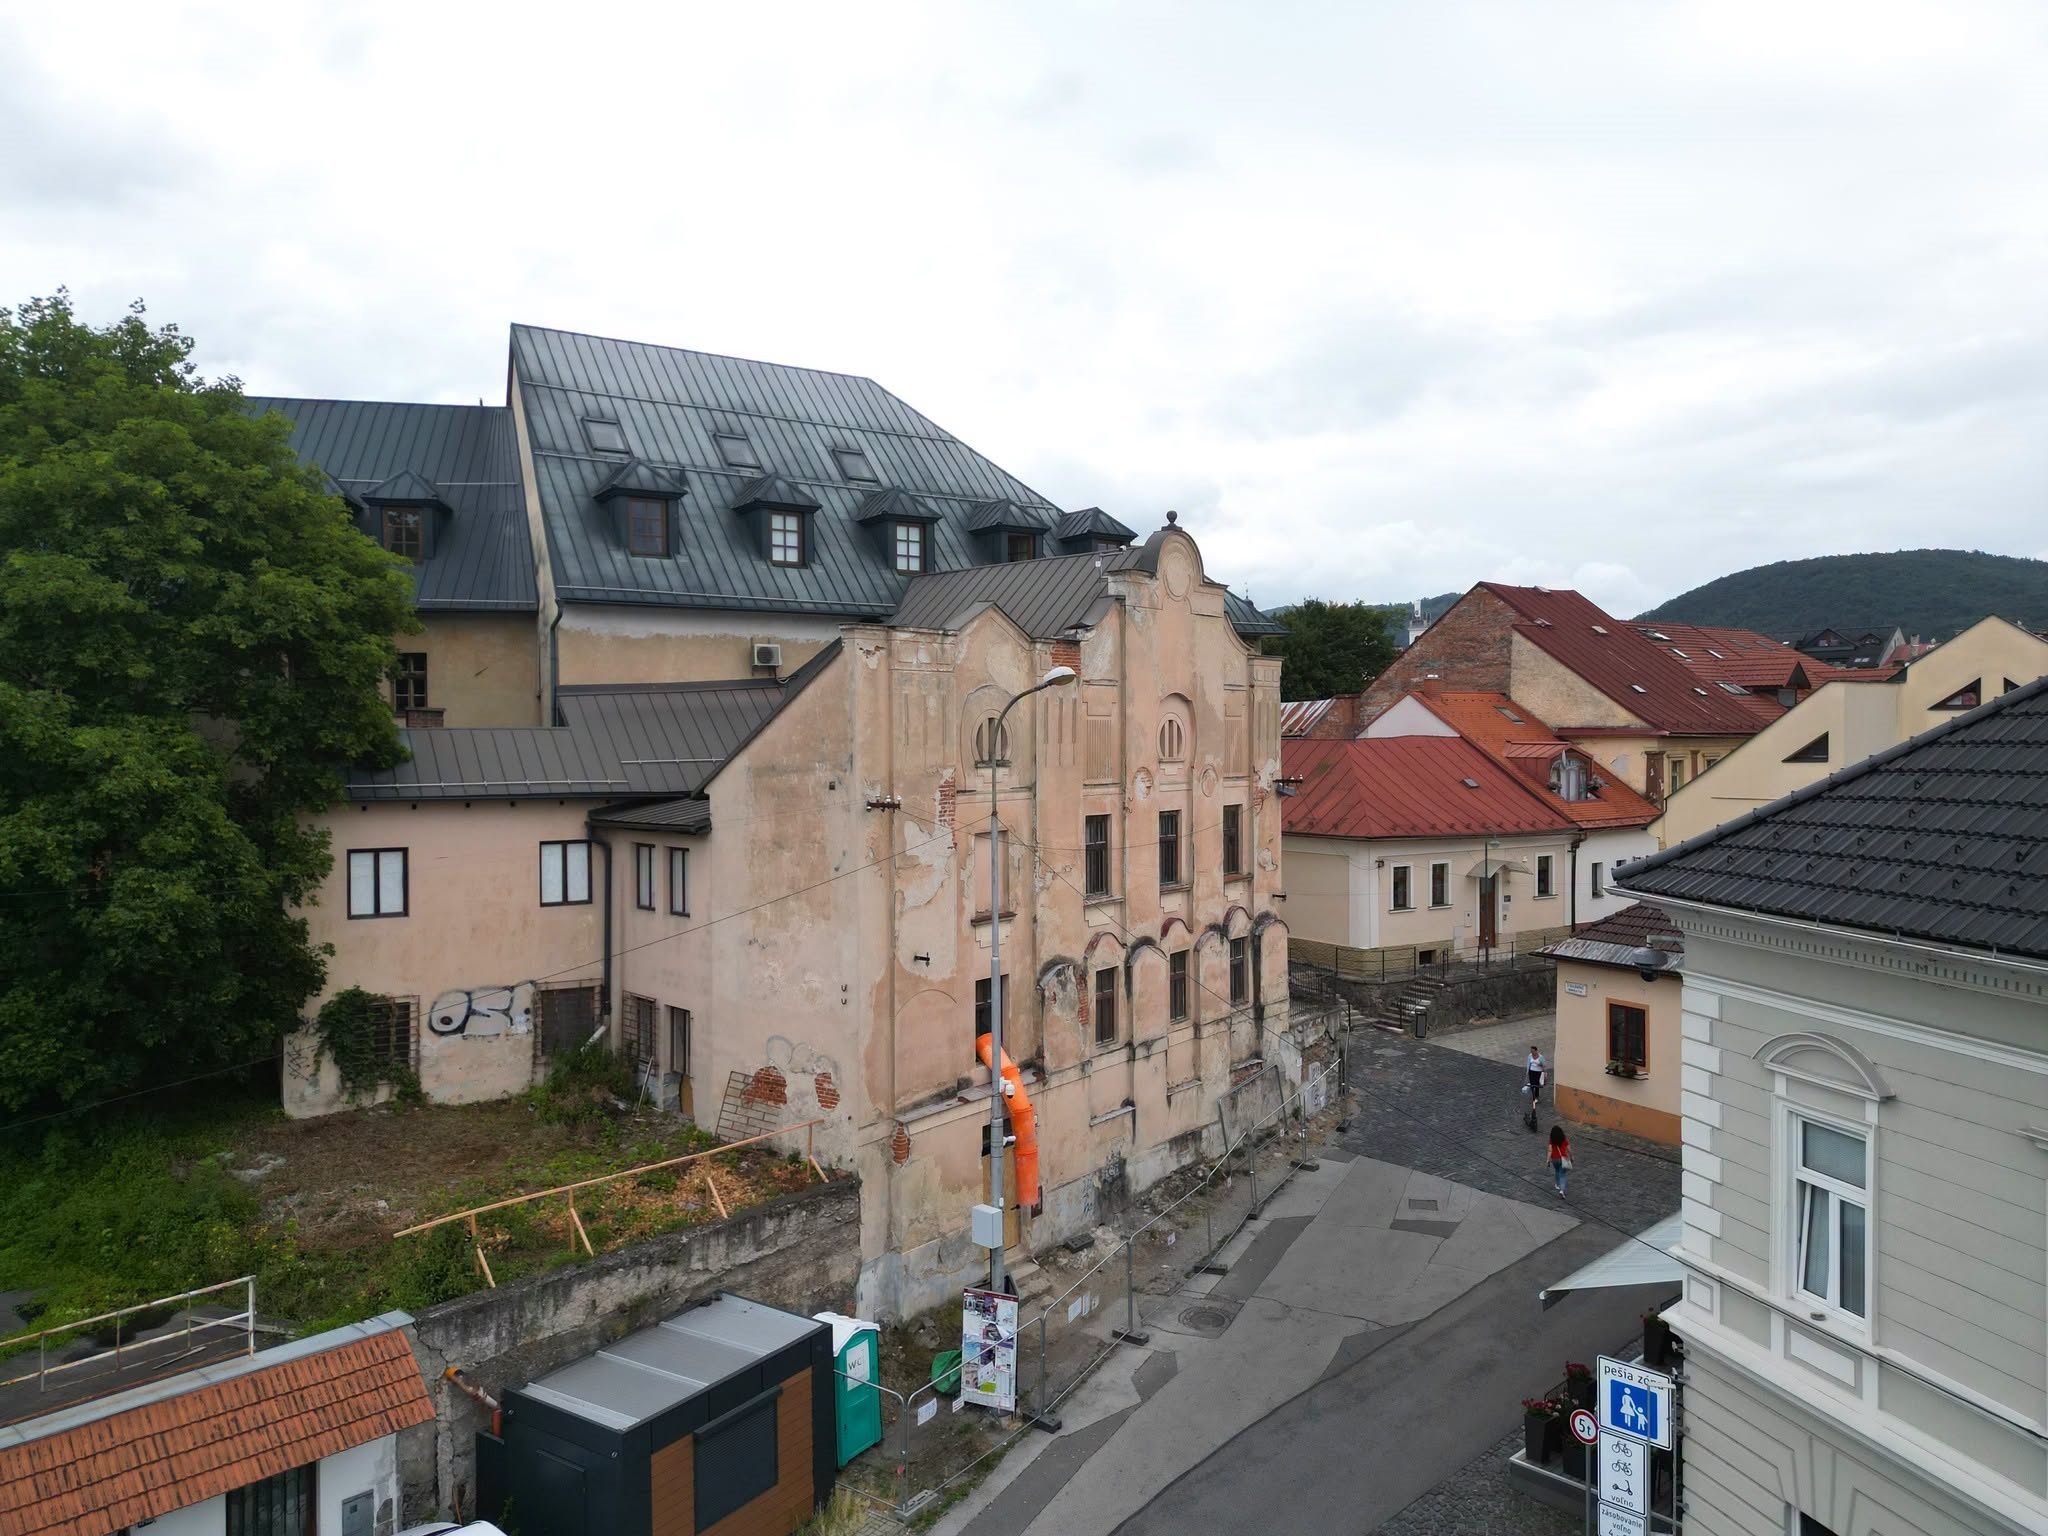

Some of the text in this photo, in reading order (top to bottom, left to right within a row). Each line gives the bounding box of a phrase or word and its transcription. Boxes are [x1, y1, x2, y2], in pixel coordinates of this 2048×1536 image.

[848, 1357, 862, 1371] WC
[1604, 1365, 1664, 1391] pešia zó
[1611, 1495, 1634, 1508] voľno
[1601, 1508, 1643, 1529] zásobovanie
[1612, 1522, 1632, 1535] voľno
